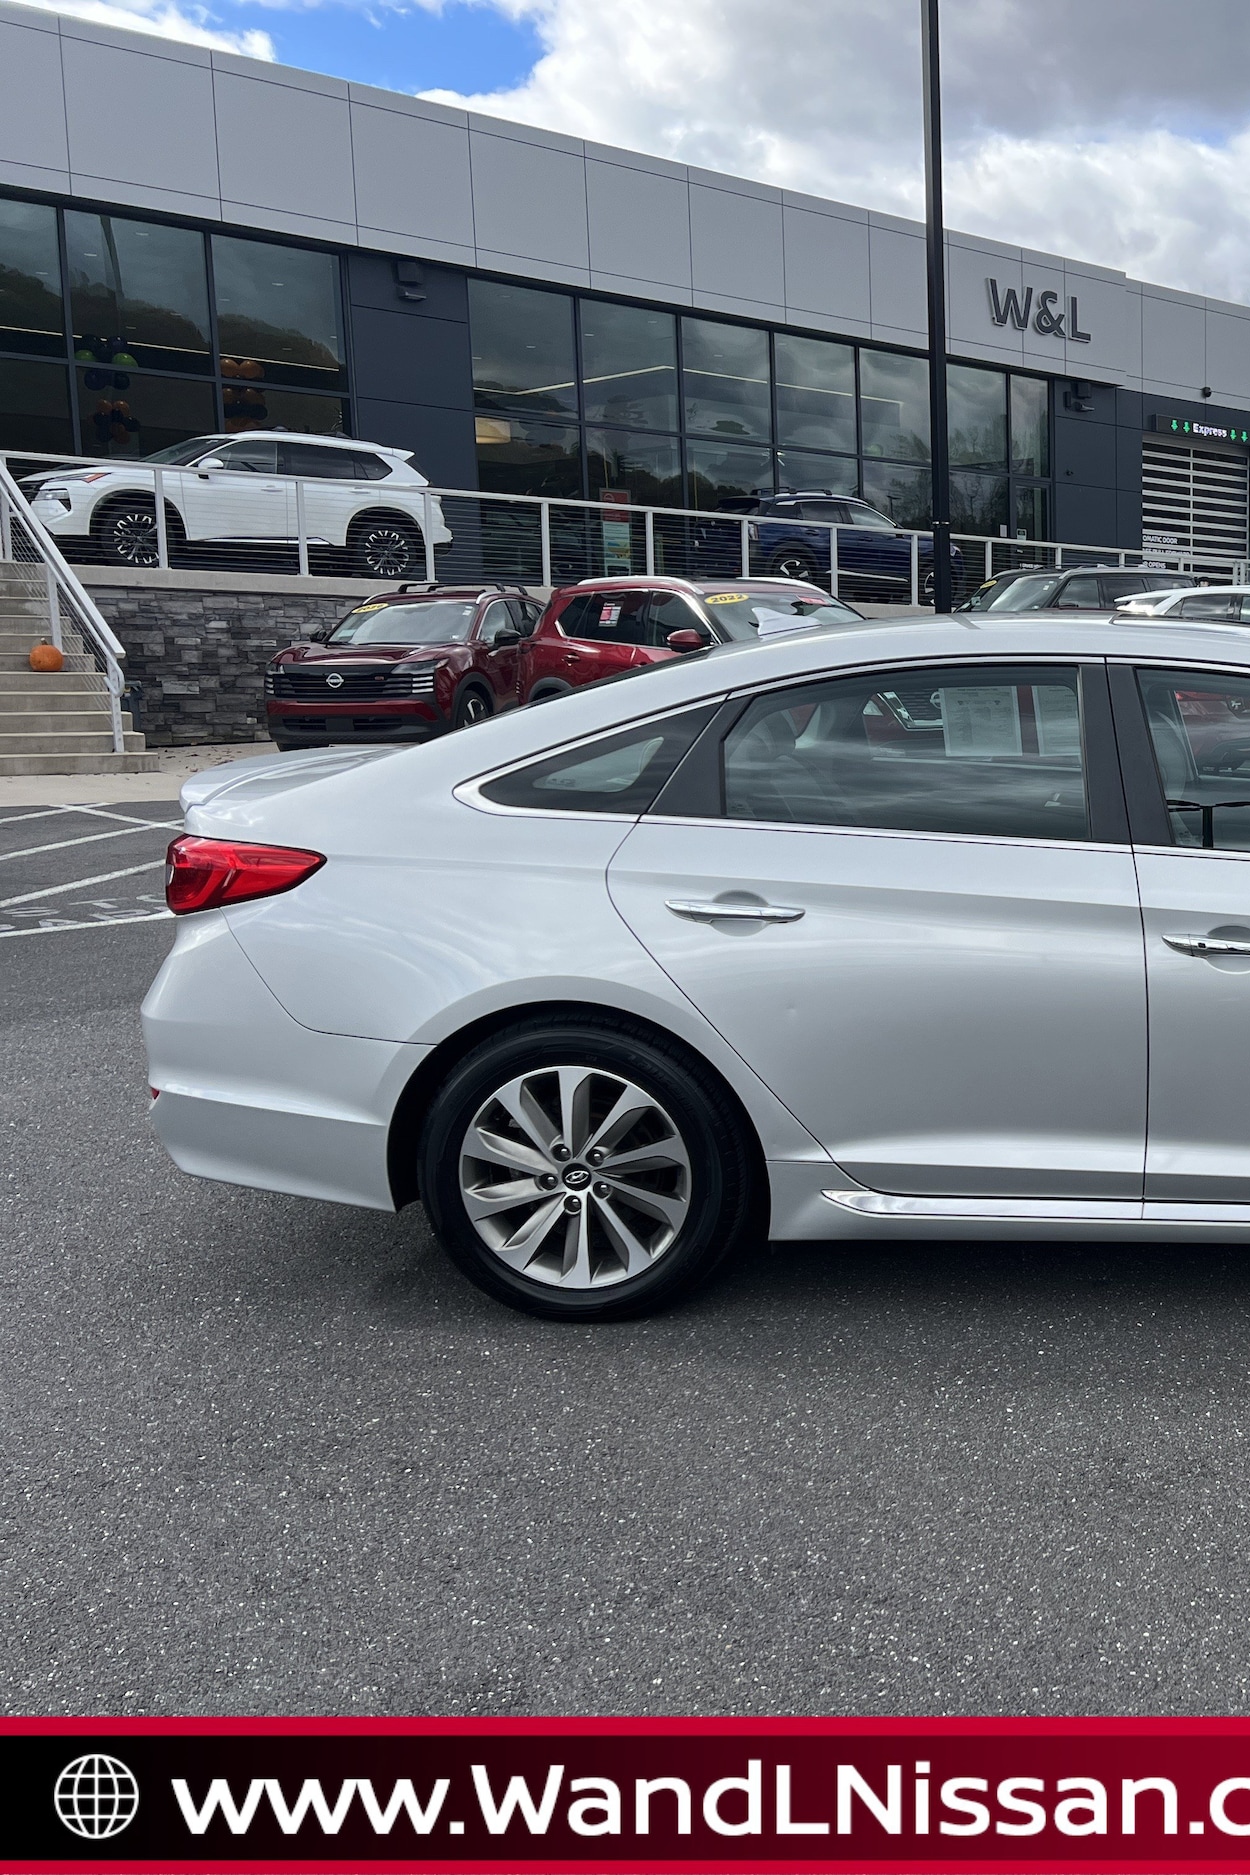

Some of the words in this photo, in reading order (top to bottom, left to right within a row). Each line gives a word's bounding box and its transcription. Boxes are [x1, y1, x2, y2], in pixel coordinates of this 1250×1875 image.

[985, 278, 1091, 343] W&L
[1192, 423, 1227, 438] Express
[710, 594, 746, 603] 2022
